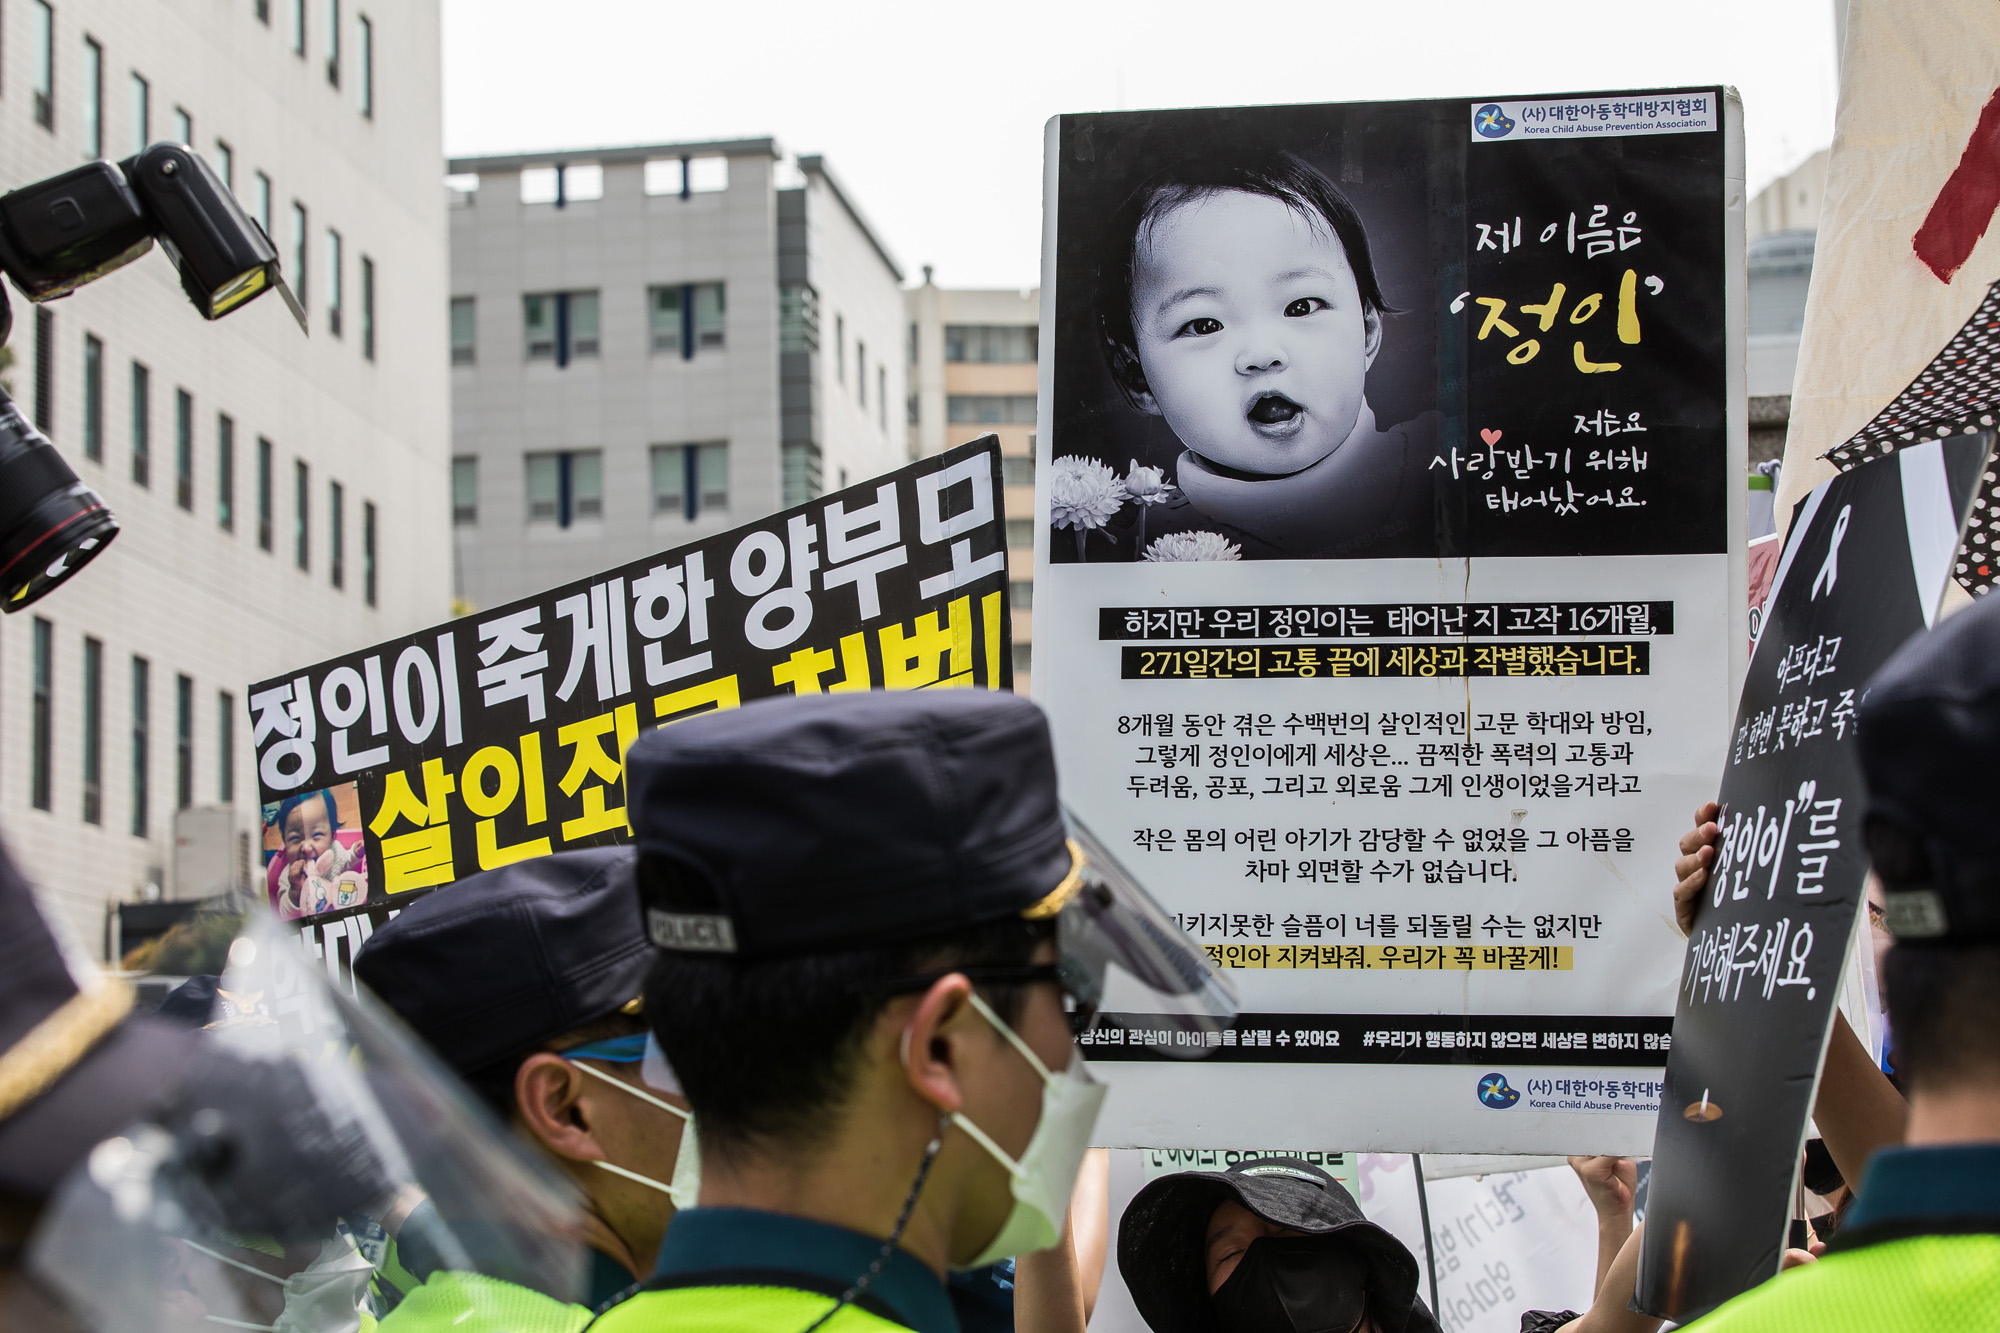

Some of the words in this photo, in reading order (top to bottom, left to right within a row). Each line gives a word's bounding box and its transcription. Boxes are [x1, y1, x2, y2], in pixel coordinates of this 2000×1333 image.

[1524, 125, 1550, 134] Korea
[1552, 124, 1574, 133] Child
[1576, 123, 1603, 132] Abuse
[1606, 121, 1654, 131] Prevention
[1656, 119, 1707, 129] Association
[1476, 217, 1521, 253] 제
[1540, 205, 1641, 259] 이름은
[1574, 409, 1647, 436] 저는요
[1429, 444, 1571, 480] 사랑받기
[1586, 446, 1647, 472] 위해
[1486, 481, 1646, 516] 태어났어요.
[250, 632, 464, 791] 정인이
[477, 550, 715, 723] 죽게한
[730, 451, 1005, 650] 양부모
[1125, 610, 1204, 638] 하지만
[1209, 609, 1259, 637] 우리
[1269, 608, 1373, 636] 정인이는
[1388, 606, 1467, 635] 태어난
[1474, 606, 1498, 634] 지
[1507, 605, 1562, 634] 고작
[1569, 603, 1657, 636] 16개월,
[1141, 649, 1259, 678] 271일간의
[1267, 647, 1321, 678] 고통
[1327, 647, 1379, 676] 끝에
[1386, 647, 1468, 675] 세상과
[1474, 645, 1641, 675] 작별했습니다.
[1777, 635, 1842, 694] 아프다고
[1118, 714, 1173, 737] 8개월
[1182, 714, 1226, 737] 동안
[1233, 714, 1275, 736] 겪은
[1283, 713, 1368, 735] 수백번의
[1378, 712, 1465, 735] 살인적인
[1474, 713, 1519, 734] 고문
[1526, 711, 1594, 735] 학대와
[1601, 711, 1651, 735] 방임,
[1772, 696, 1828, 754] 못하고
[1135, 745, 1199, 768] 그렇게
[1209, 744, 1315, 768] 정인이에게
[1324, 744, 1408, 767] 세상은...
[1415, 742, 1485, 768] 끔찍한
[1490, 743, 1555, 766] 폭력의
[1565, 742, 1633, 766] 고통과
[1127, 775, 1197, 800] 두려움,
[1205, 776, 1254, 800] 공포,
[1262, 775, 1328, 797] 그리고
[1336, 775, 1401, 797] 외로움
[1409, 774, 1451, 797] 그게
[1462, 774, 1641, 798] 인생이었을거라고
[1133, 829, 1176, 851] 작은
[1183, 829, 1225, 851] 몸의
[1235, 829, 1275, 851] 어린
[1286, 828, 1351, 851] 아기가
[1359, 828, 1426, 852] 감당할
[1433, 829, 1454, 851] 수
[1463, 828, 1529, 852] 없었을
[1536, 830, 1559, 849] 그
[1567, 828, 1634, 852] 아픔을
[1245, 860, 1290, 882] 차마
[1297, 860, 1363, 883] 외면할
[1370, 860, 1414, 883] 수가
[1422, 860, 1516, 883] 없습니다.
[1281, 914, 1345, 937] 슬픔이
[1356, 914, 1399, 938] 너를
[1407, 914, 1471, 938] 되돌릴
[1481, 914, 1525, 938] 수는
[1534, 915, 1602, 938] 없지만
[1205, 945, 1270, 969] 정인아
[1277, 945, 1371, 969] 지켜봐줘.
[1379, 946, 1446, 969] 우리가
[1454, 947, 1476, 970] 꼭
[1483, 946, 1557, 970] 바꿀게!
[1685, 918, 1816, 1007] 기억해주세요.
[1128, 1029, 1172, 1047] 관심이
[1241, 1030, 1271, 1046] 살릴
[1276, 1030, 1290, 1046] 수
[1295, 1031, 1339, 1046] 있어요
[1363, 1031, 1421, 1047] #우리가
[1426, 1031, 1486, 1048] 행동하지
[1491, 1032, 1536, 1048] 않으면
[1542, 1033, 1587, 1049] 세상은
[1593, 1033, 1638, 1049] 변하지
[1529, 1100, 1556, 1108] Korea
[1558, 1099, 1581, 1109] Child
[1584, 1100, 1612, 1110] Abuse
[1614, 1101, 1660, 1111] Preventio
